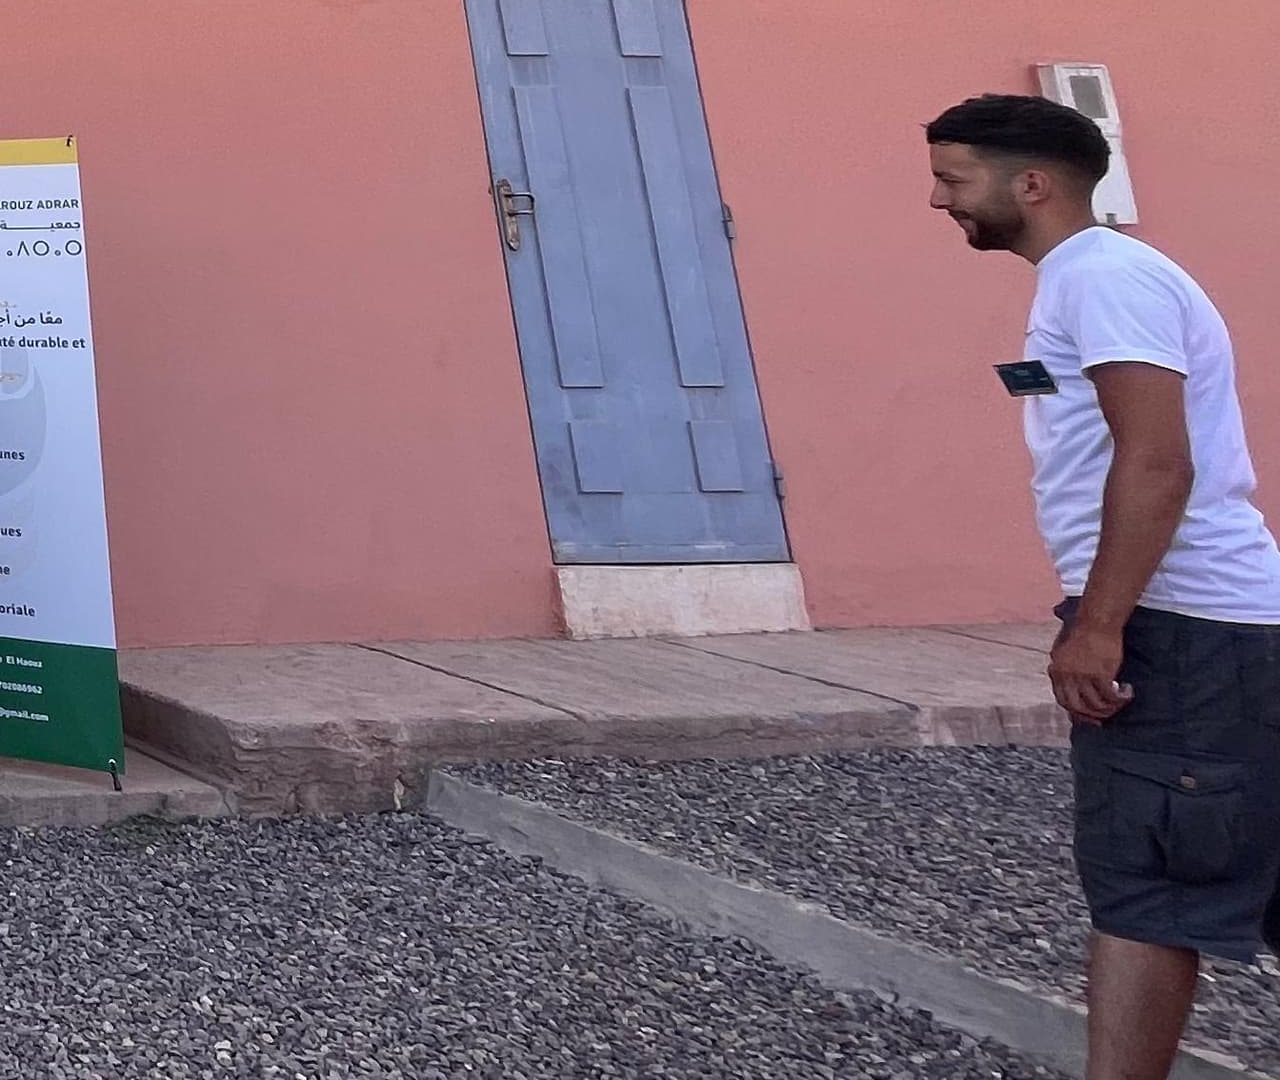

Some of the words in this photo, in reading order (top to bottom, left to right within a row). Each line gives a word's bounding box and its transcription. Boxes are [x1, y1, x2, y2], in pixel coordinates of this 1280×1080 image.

[36, 199, 79, 209] ADRAR
[14, 314, 36, 328] من
[18, 336, 69, 348] durable
[72, 338, 86, 348] et
[6, 655, 15, 665] El
